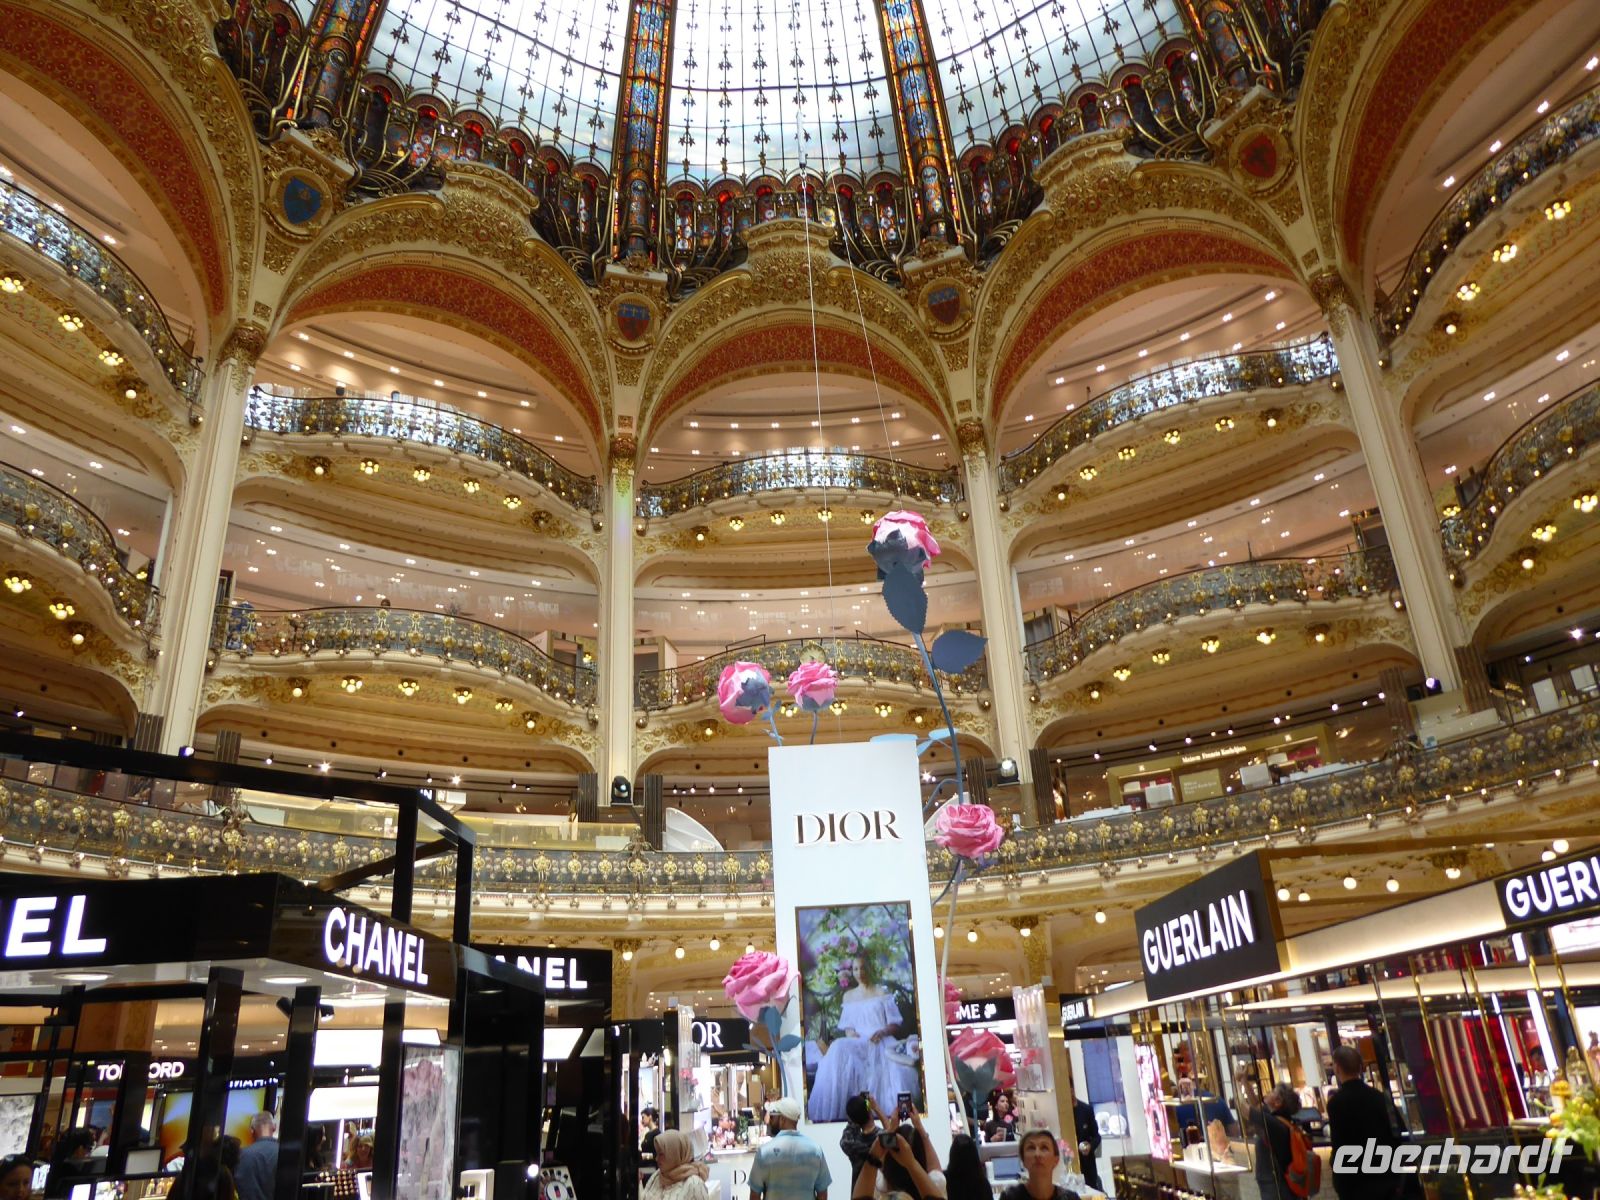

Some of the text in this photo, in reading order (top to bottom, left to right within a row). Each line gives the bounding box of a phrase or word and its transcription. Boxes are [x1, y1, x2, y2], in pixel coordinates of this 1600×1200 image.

[793, 809, 903, 844] DIOR
[324, 906, 429, 986] CHANEL
[1143, 889, 1254, 974] GUERLAIN
[494, 954, 588, 989] NEL
[956, 1003, 981, 1020] ME
[97, 1061, 185, 1081] TO ORD
